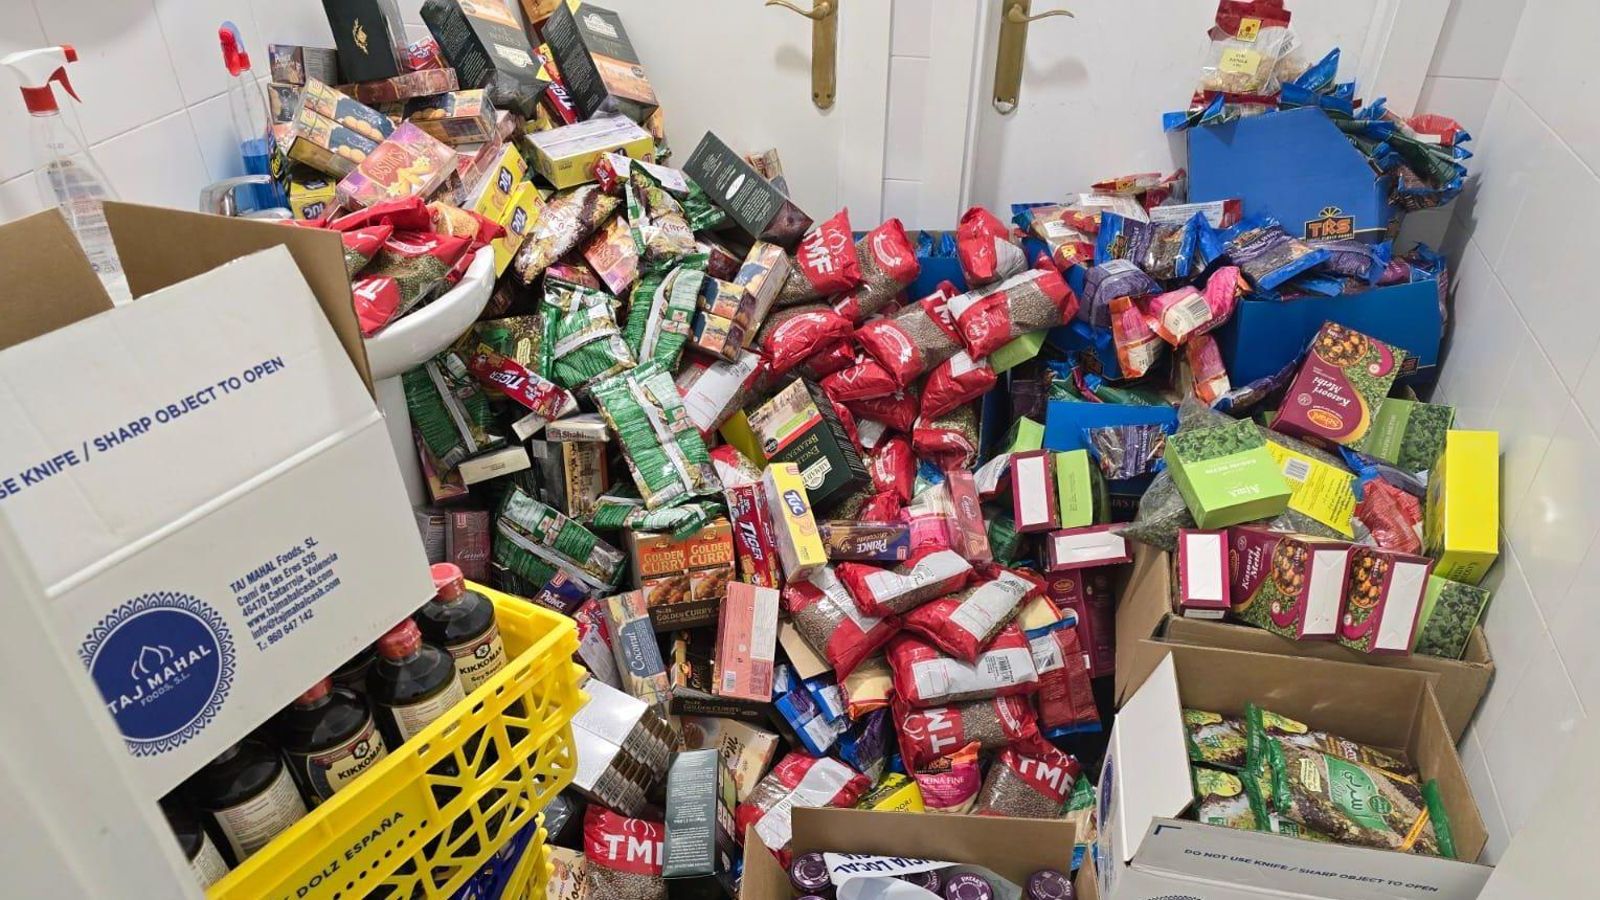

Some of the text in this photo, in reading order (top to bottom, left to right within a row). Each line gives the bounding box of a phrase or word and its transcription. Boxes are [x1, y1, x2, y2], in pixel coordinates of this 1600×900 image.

[1309, 217, 1351, 239] TRS
[802, 227, 833, 275] TMF
[489, 371, 526, 391] TIGER
[1311, 376, 1342, 393] Methi
[1312, 386, 1352, 407] Kasoori
[20, 450, 80, 486] KNIFE
[83, 441, 90, 462] /
[93, 417, 152, 452] SHARP
[155, 386, 217, 423] OBJECT
[217, 377, 241, 394] TO
[243, 356, 285, 383] OPEN
[787, 492, 806, 514] TUC
[643, 551, 684, 564] GOLDEN
[689, 542, 730, 556] GOLDEN
[689, 550, 733, 566] CURRY
[741, 521, 763, 560] TIGER
[856, 539, 888, 553] PRINCE
[230, 578, 246, 593] TAJ
[246, 561, 277, 584] MAHAL
[276, 545, 305, 566] Foods,
[259, 580, 271, 593] de
[270, 573, 284, 586] les
[283, 562, 302, 578] Eres
[302, 551, 317, 567] 526
[642, 558, 687, 573] CURRY
[1242, 548, 1254, 590] Kasoori
[1252, 547, 1262, 578] Methi
[242, 594, 268, 617] 46470
[305, 553, 339, 576] Valencia
[246, 568, 334, 629] www.tajmahalcash.com
[540, 590, 567, 608] PRINCE
[250, 577, 341, 640] info@tajmahalcash.com
[267, 629, 284, 645] 960
[283, 618, 298, 634] 647
[299, 608, 314, 623] 142
[656, 606, 714, 621] GOLDEN CURRY
[631, 632, 645, 671] Coconut
[107, 644, 212, 714] TAJ MAHAL
[924, 707, 958, 754] TM
[1018, 755, 1074, 796] TMF
[296, 860, 341, 898] DOLZ
[343, 811, 404, 861] ESPAÑA
[834, 862, 887, 874] LOCAL
[1204, 852, 1228, 860] NOT
[1230, 856, 1251, 864] USE
[1254, 860, 1288, 871] KNIFE
[1299, 868, 1338, 878] SHARP
[1339, 873, 1385, 884] OBJECT
[1405, 883, 1439, 892] OPEN
[565, 867, 587, 900] ochi
